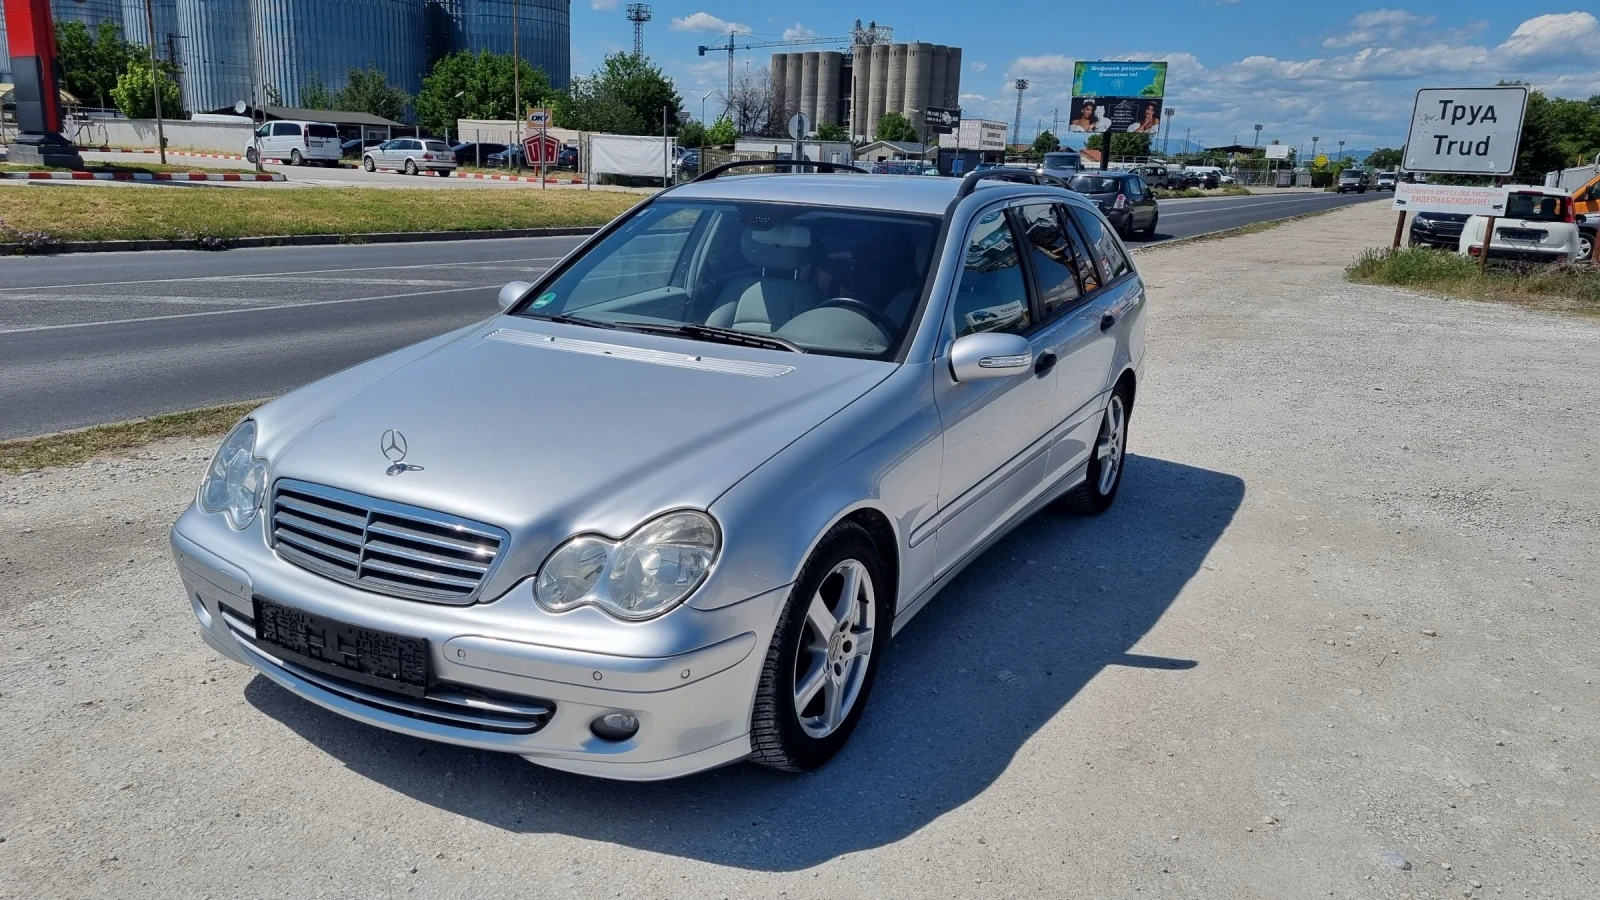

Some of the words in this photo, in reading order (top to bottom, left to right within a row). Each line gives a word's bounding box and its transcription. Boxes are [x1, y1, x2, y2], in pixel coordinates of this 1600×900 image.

[1438, 99, 1497, 126] Труд
[1433, 134, 1491, 156] Trud
[1400, 187, 1434, 195] НАСЕЛЕНОТО
[1411, 195, 1490, 206] ВИДЕОНАБЛЮДЕНИЕ!
